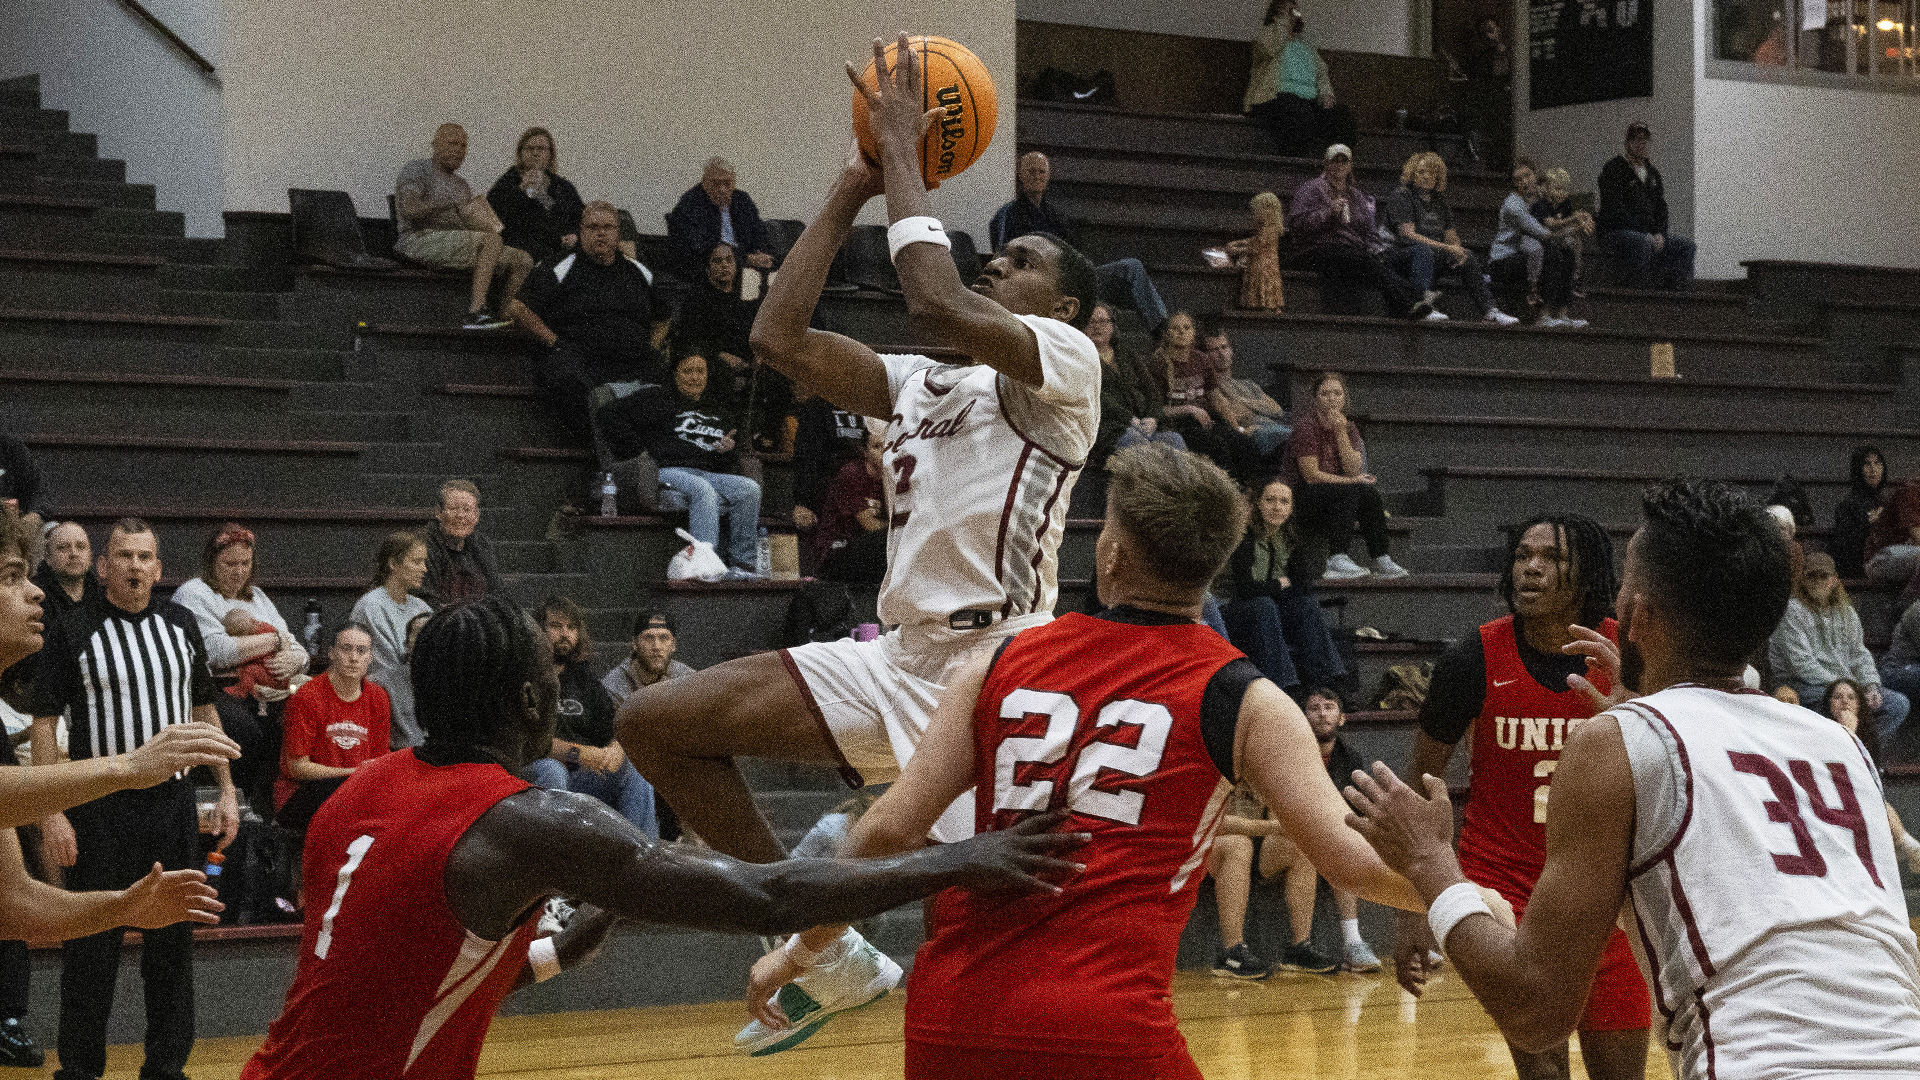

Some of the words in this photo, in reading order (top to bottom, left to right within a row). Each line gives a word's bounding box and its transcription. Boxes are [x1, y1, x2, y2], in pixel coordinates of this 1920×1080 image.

[936, 83, 964, 176] Wilson
[883, 399, 977, 453] Ceral
[992, 688, 1174, 827] 22
[1494, 716, 1588, 752] UNI
[1726, 750, 1886, 891] 34
[313, 834, 375, 961] 1
